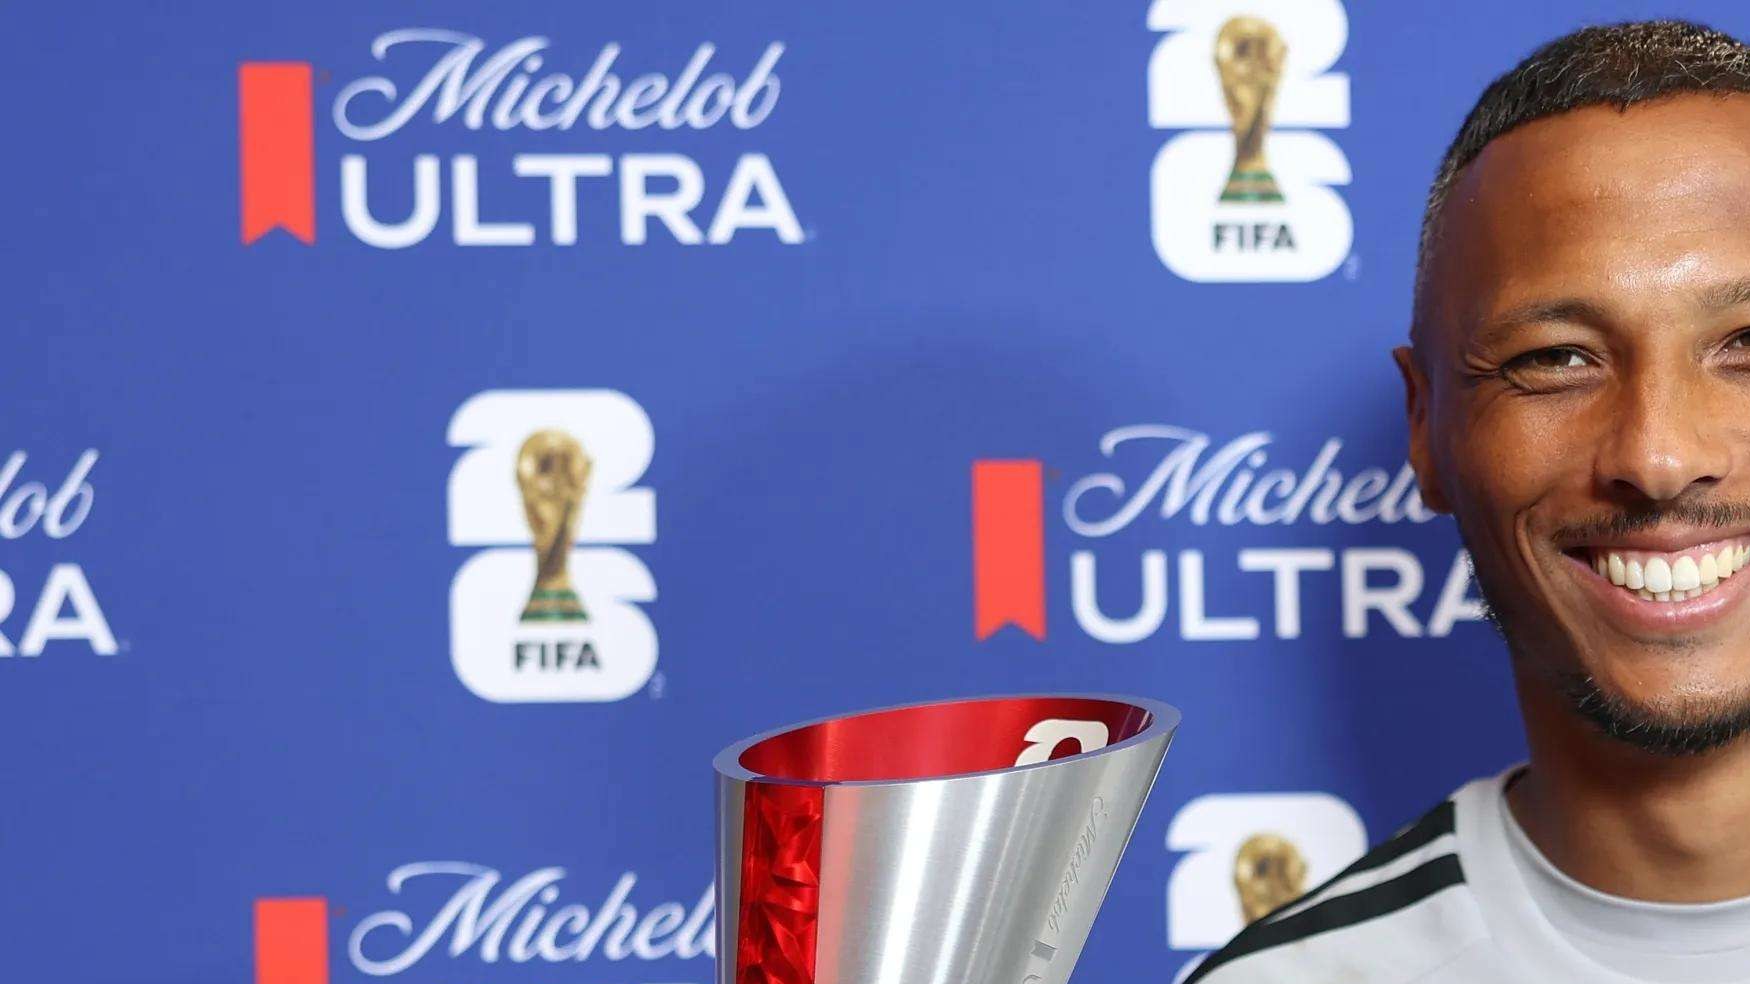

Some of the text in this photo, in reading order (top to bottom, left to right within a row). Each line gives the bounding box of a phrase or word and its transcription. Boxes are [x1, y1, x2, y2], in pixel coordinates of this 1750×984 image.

[333, 28, 786, 142] Michelob
[341, 153, 806, 249] ULTRA
[1212, 221, 1297, 251] FIFA
[512, 640, 602, 671] FIFA
[1048, 795, 1105, 934] Michelob
[348, 861, 716, 976] Michel
